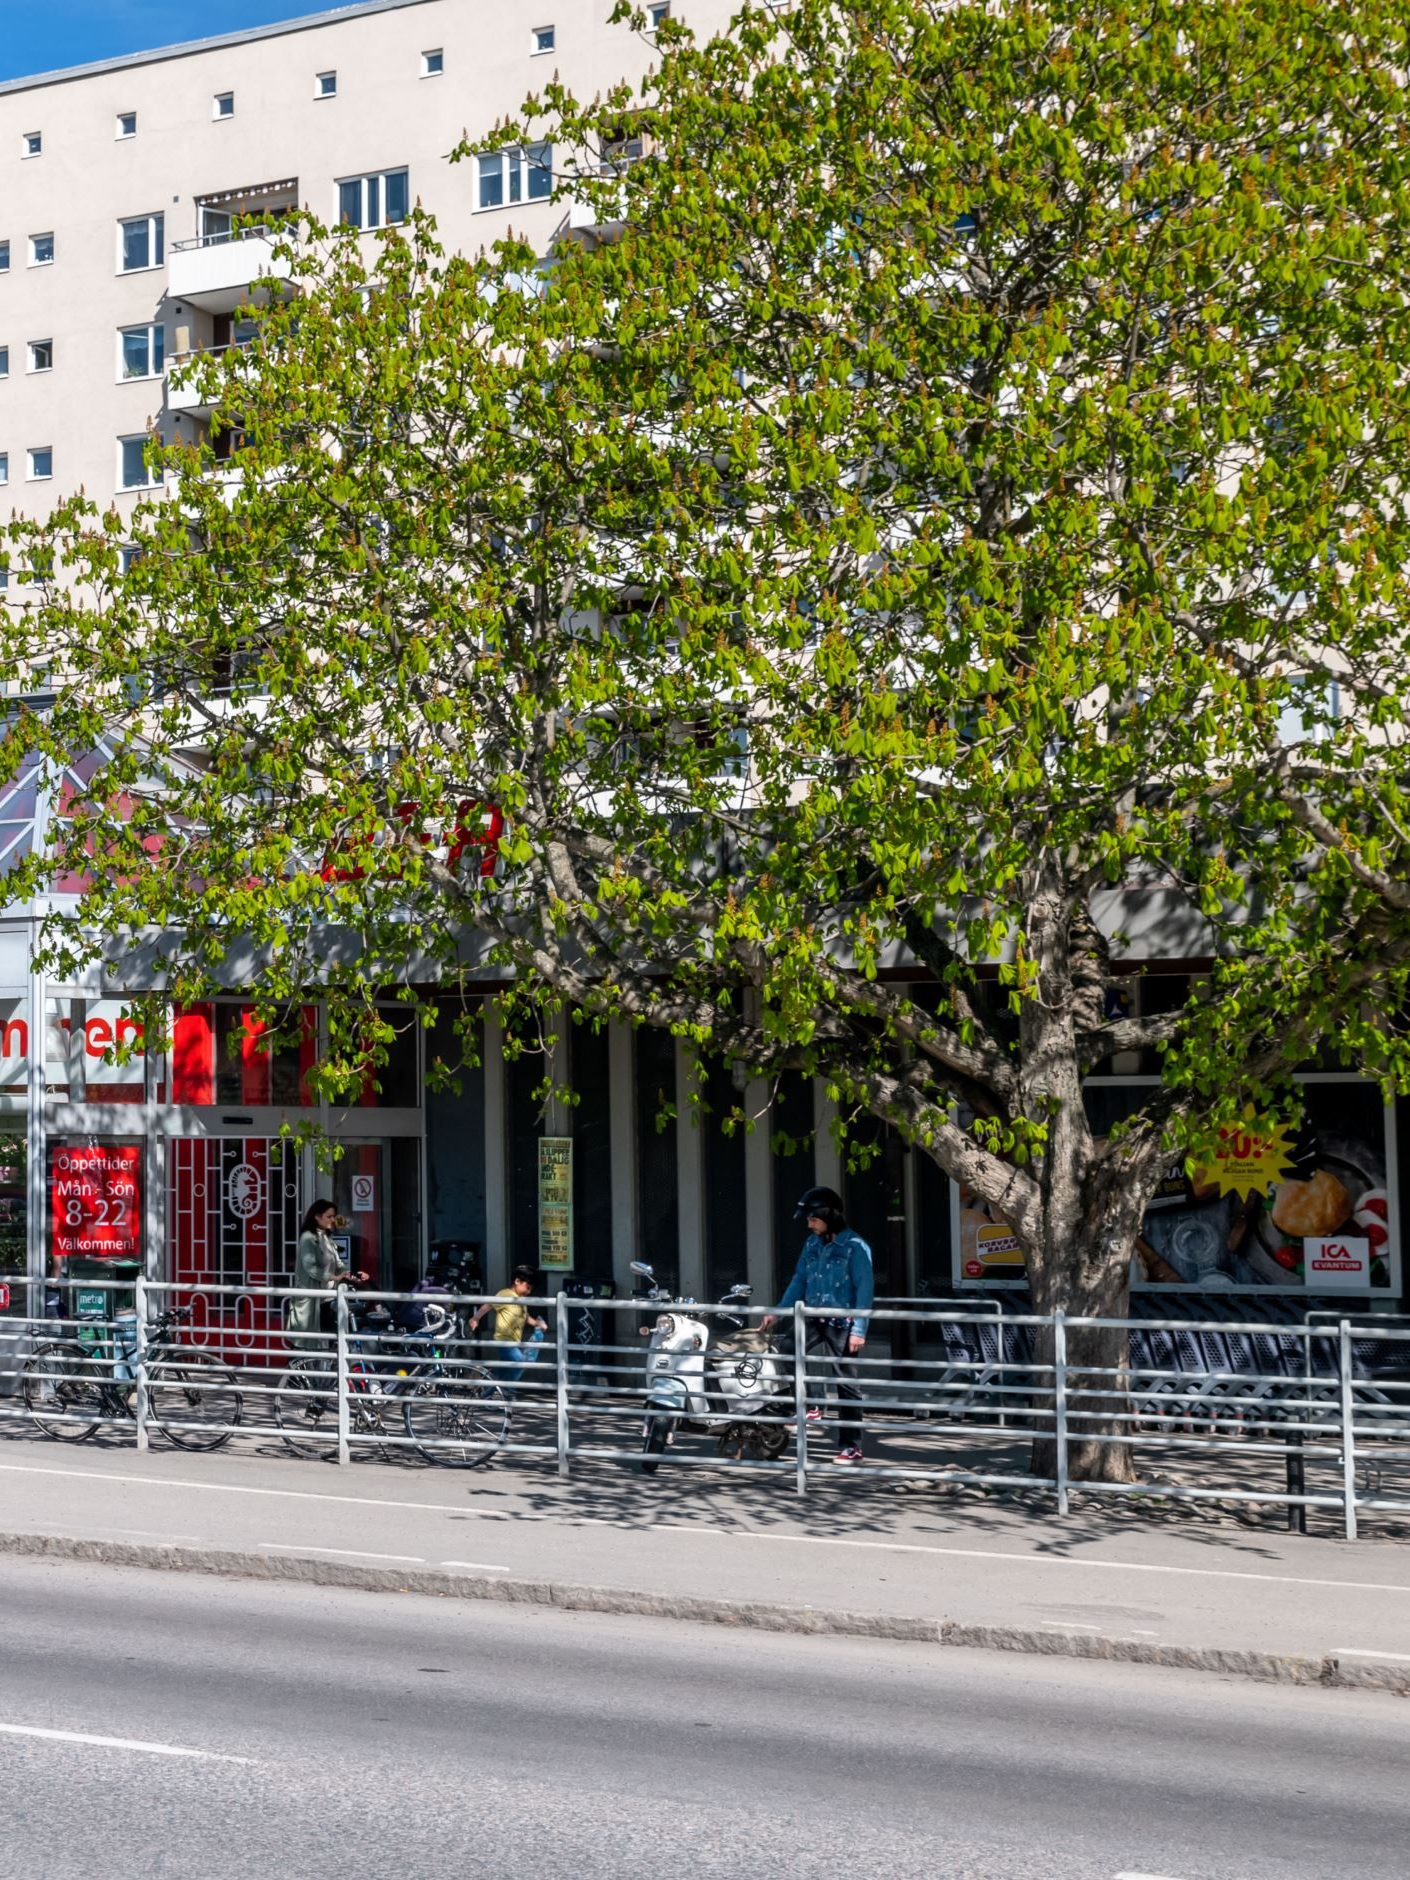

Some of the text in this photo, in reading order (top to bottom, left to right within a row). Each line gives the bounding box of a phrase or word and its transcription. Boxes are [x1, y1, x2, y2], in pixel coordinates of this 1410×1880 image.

[58, 1153, 135, 1174] Öppettider
[57, 1180, 91, 1197] Mån
[106, 1180, 135, 1196] Sön
[65, 1199, 127, 1226] 8-22
[57, 1237, 135, 1250] Välkommen!
[1321, 1244, 1352, 1259] ICA
[1314, 1261, 1360, 1269] KVANTUM
[79, 1293, 104, 1305] metro
